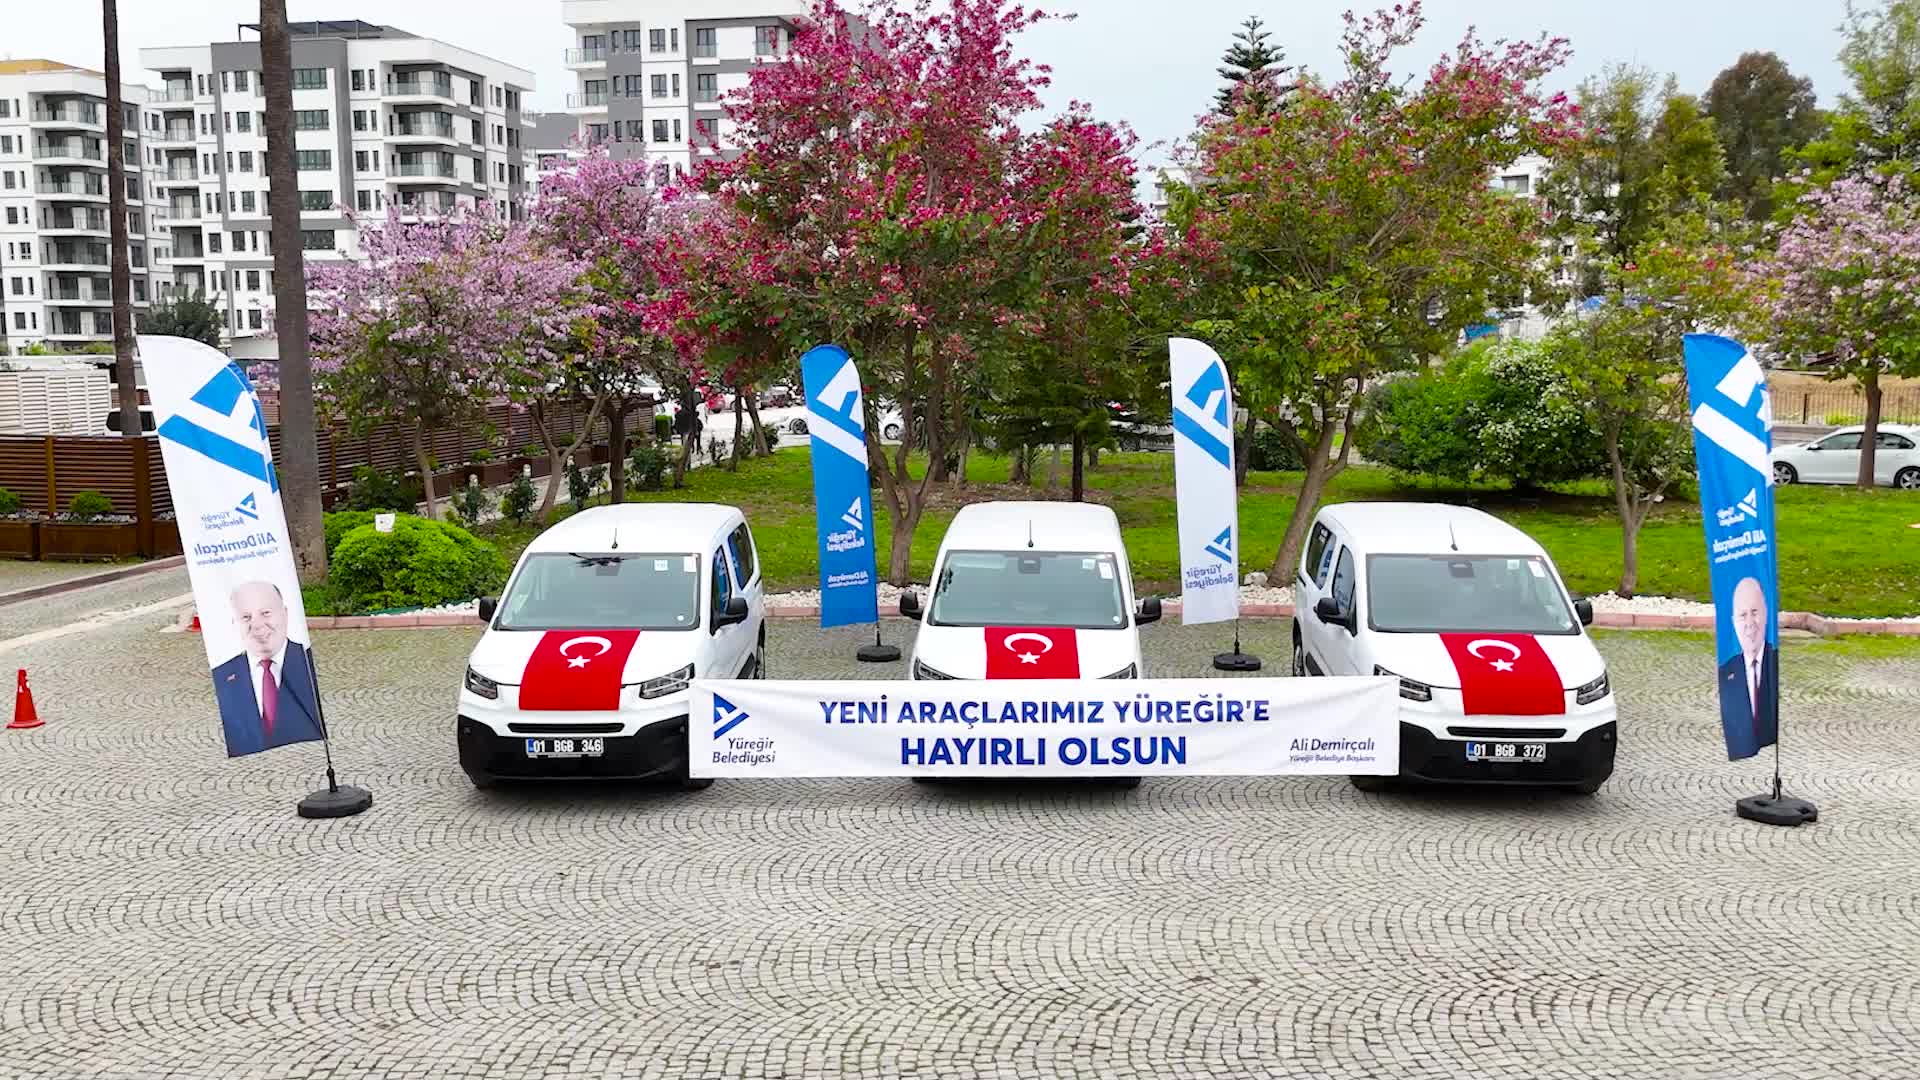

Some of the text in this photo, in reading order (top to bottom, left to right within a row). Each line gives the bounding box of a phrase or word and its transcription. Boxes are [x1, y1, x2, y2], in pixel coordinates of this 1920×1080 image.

[819, 693, 1270, 729] YENİ ARAÇLARIMIZ YÜREĞİR'E
[533, 739, 601, 753] 01 BGB 346
[728, 737, 775, 752] Yüreğir
[901, 736, 1187, 766] HAYIRLI OLSUN
[1290, 737, 1375, 753] Ali Demirçalı
[1473, 743, 1544, 757] 01 BGB 372
[712, 750, 776, 766] Belediyesi
